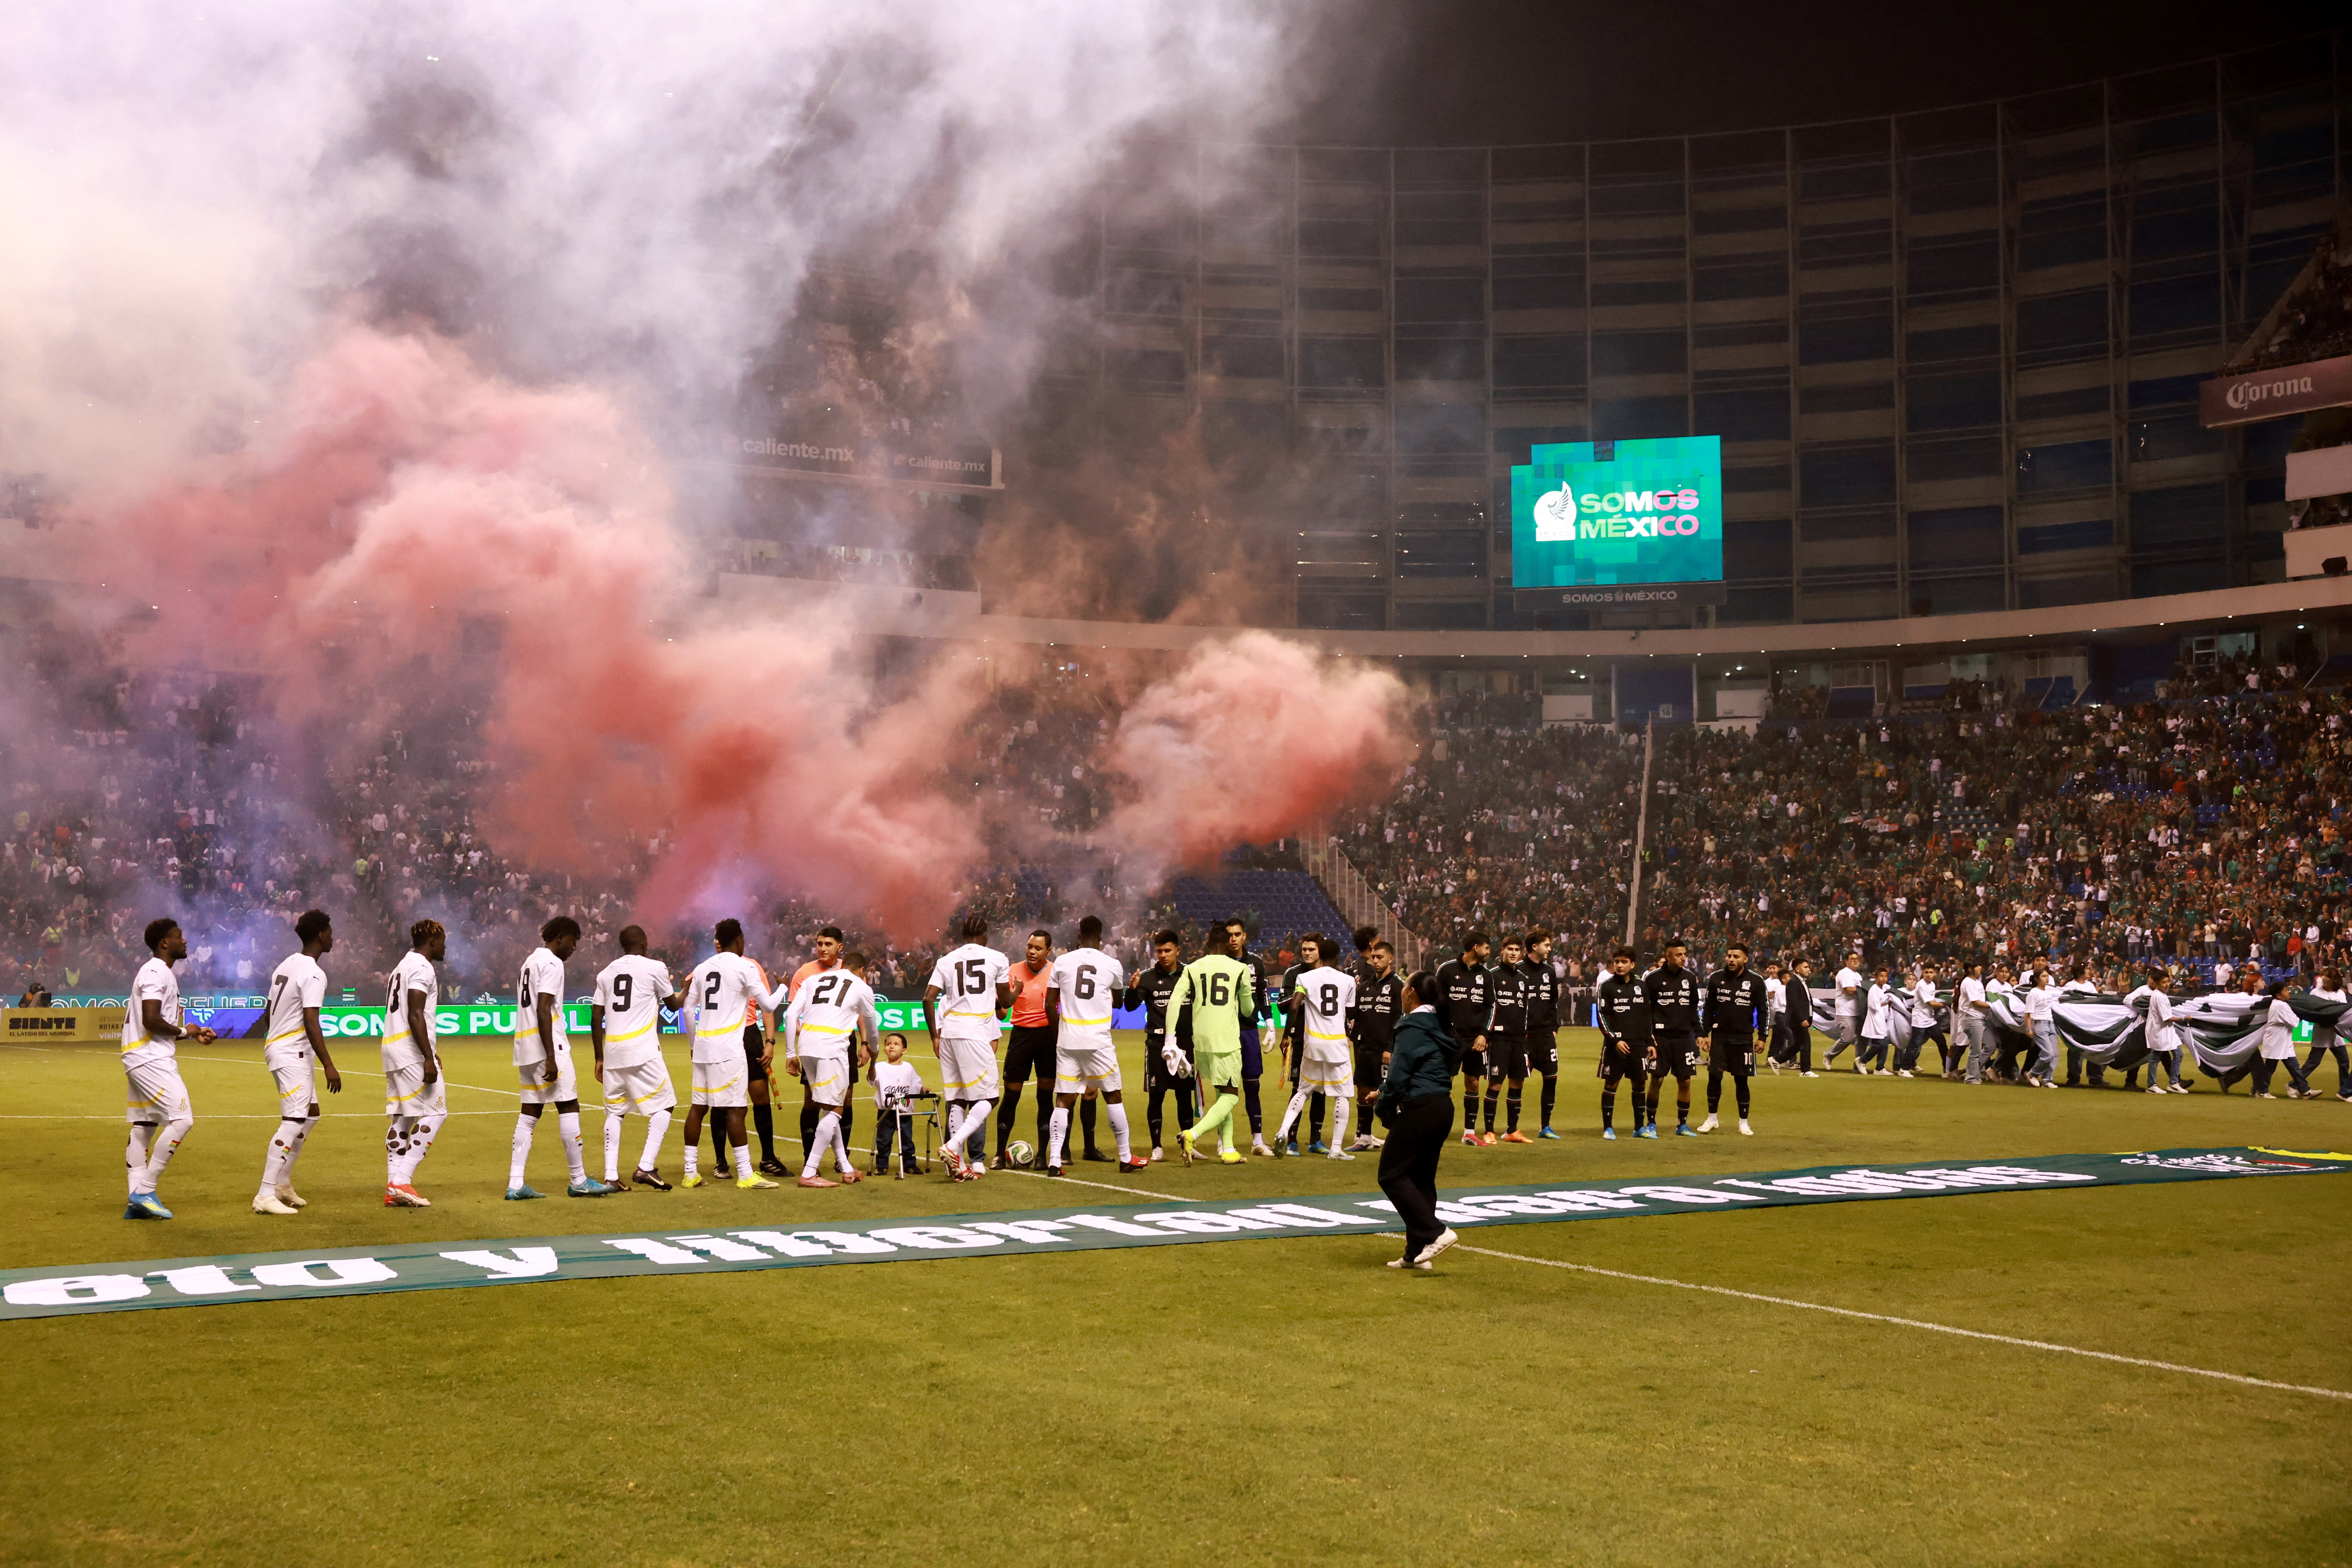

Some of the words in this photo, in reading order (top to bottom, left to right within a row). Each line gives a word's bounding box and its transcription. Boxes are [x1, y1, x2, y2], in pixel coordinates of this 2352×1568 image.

[2226, 376, 2313, 410] Corona
[743, 437, 854, 462] caliente.mx
[909, 455, 985, 473] caliente.mx
[1580, 489, 1699, 513] SOMOS
[1580, 514, 1699, 539] MÉXICO
[1563, 593, 1613, 603] SOMOS
[1625, 590, 1677, 601] MÉXICO
[386, 973, 401, 1014] 13
[612, 974, 633, 1012] 9
[705, 972, 721, 1010] 2
[811, 976, 853, 1007] 21
[955, 959, 985, 997] 15
[1074, 965, 1097, 1000] 6
[1200, 973, 1230, 1006] 16
[272, 975, 289, 1015] 7
[1320, 984, 1338, 1016] 8
[9, 1017, 76, 1029] SIENTE
[319, 1013, 460, 1037] SOS
[1381, 1064, 1388, 1078] 6
[1744, 1053, 1753, 1065] 10
[439, 1247, 558, 1279] y
